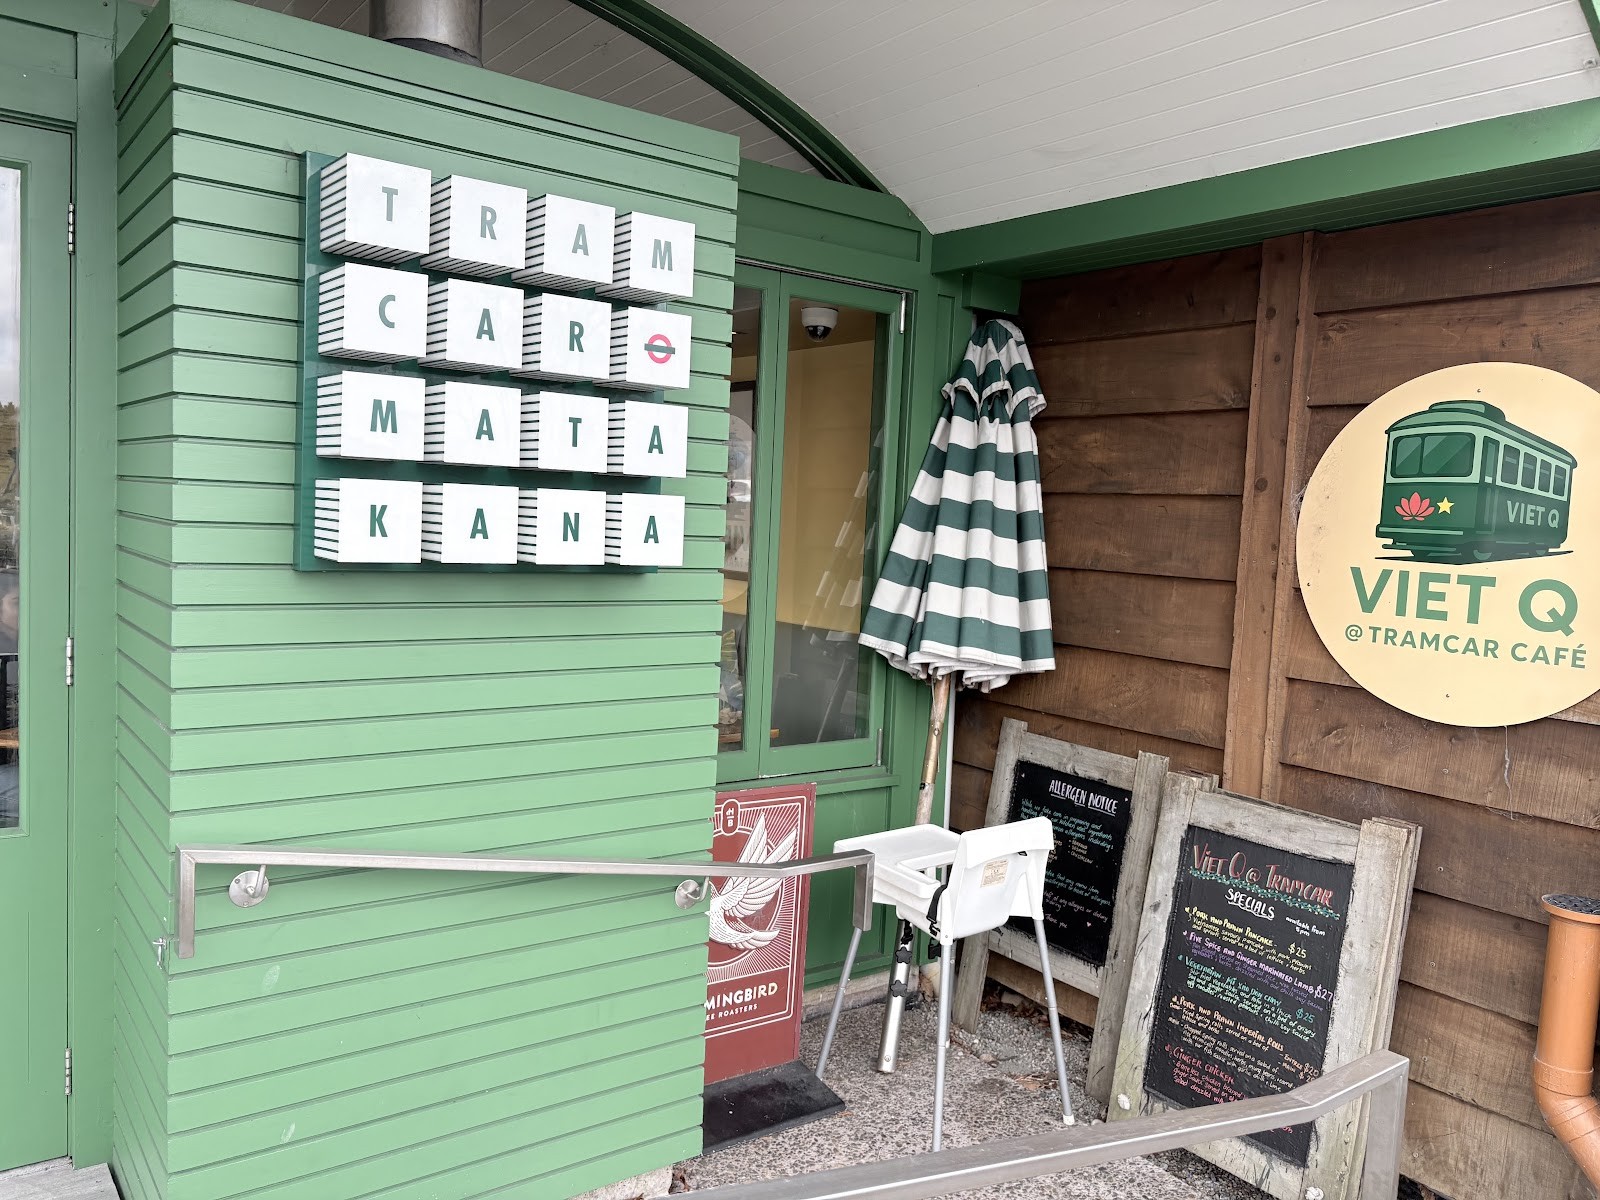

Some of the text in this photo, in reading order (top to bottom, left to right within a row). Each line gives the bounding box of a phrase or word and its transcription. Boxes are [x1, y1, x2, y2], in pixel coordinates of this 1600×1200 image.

[382, 186, 673, 271] TRAM
[379, 294, 584, 353] CAR
[370, 399, 664, 455] MATA
[369, 504, 660, 544] KANA
[1507, 500, 1560, 529] VIET Q
[1350, 566, 1578, 637] VIET Q
[1345, 624, 1587, 670] @ TRAMCAR CAFÉ
[1049, 779, 1118, 814] ALLERGEN NOTICE
[1229, 852, 1246, 878] Q
[1245, 867, 1261, 883] @
[1265, 864, 1335, 908] TRAMCAR
[1224, 888, 1275, 919] SPECIALS
[1221, 930, 1241, 943] savoury
[1286, 916, 1326, 936] available from
[1288, 943, 1306, 958] $25
[1289, 962, 1305, 974] herbs
[1313, 984, 1333, 1002] $27
[719, 1003, 758, 1018] ROASTERS
[1243, 999, 1262, 1010] served
[1277, 1015, 1287, 1023] bed
[1289, 1018, 1297, 1027] of
[1297, 1025, 1316, 1038] crispy
[1276, 1008, 1292, 1019] thick
[1296, 1009, 1315, 1023] $25
[1267, 1037, 1283, 1051] ROLLS
[1292, 1029, 1309, 1041] sauce
